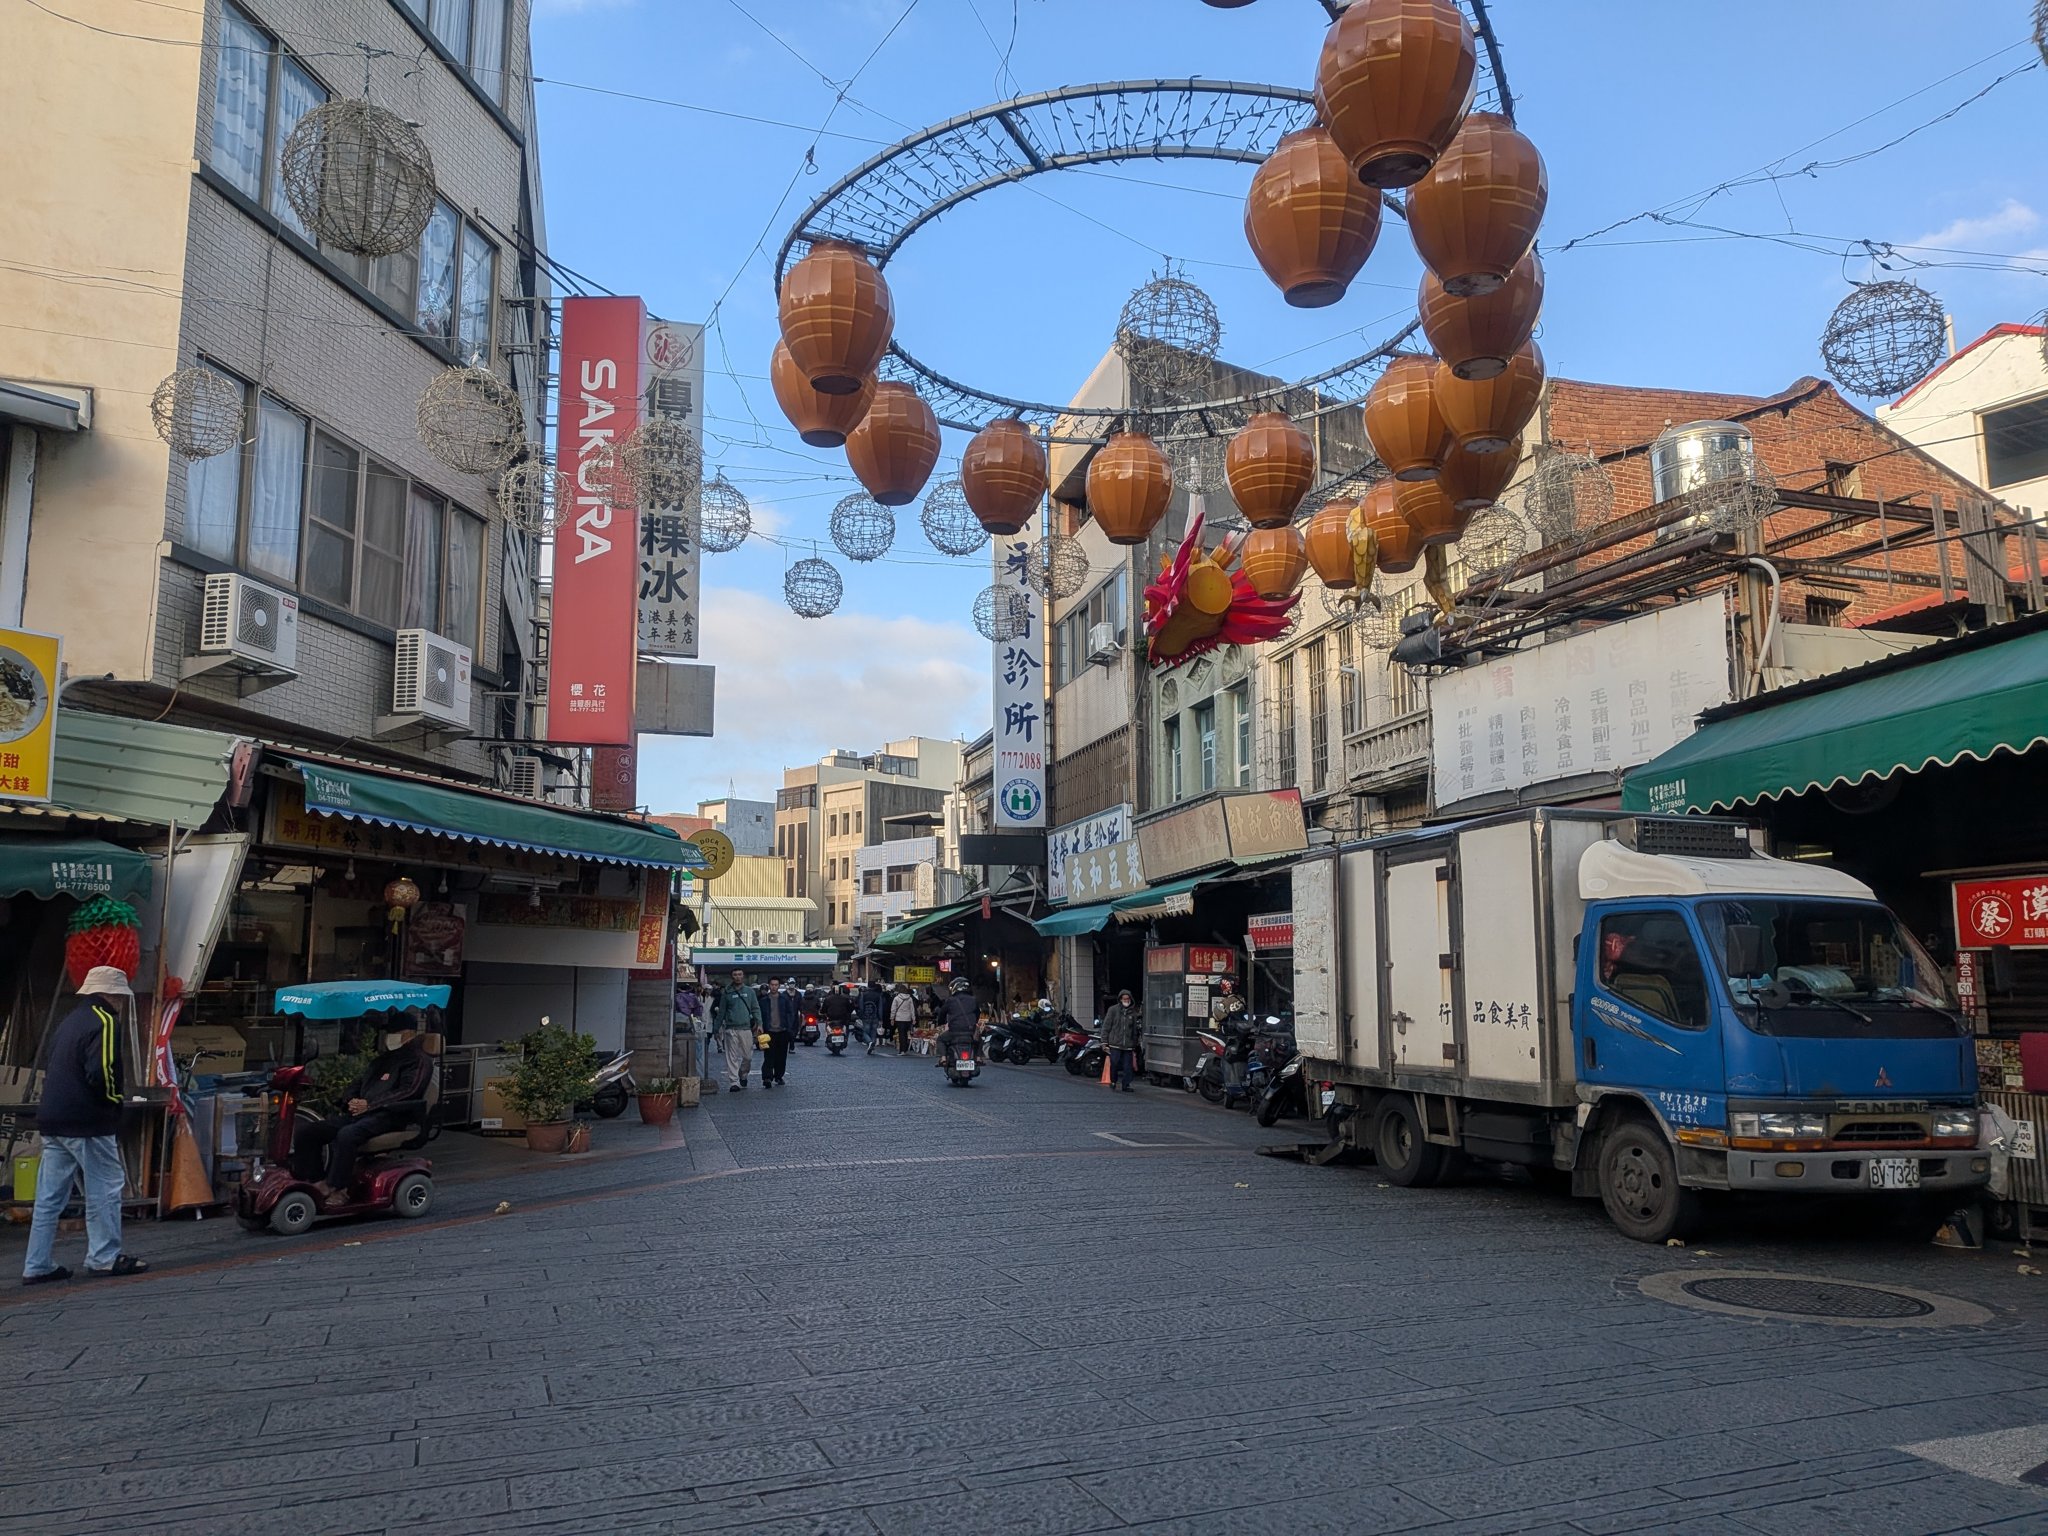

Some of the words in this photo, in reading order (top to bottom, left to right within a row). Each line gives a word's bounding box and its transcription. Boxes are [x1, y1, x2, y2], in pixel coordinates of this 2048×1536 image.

[575, 358, 617, 564] SAKURA
[570, 683, 606, 697] 櫻花
[1628, 679, 1650, 756] 肉品加工
[1001, 751, 1041, 770] 7772088
[1458, 722, 1475, 790] 批發零售
[1651, 798, 1686, 813] 04-7778500
[699, 837, 720, 846] DOCK
[1072, 841, 1142, 898] 永和豆漿
[55, 881, 111, 891] 04-7778500
[1978, 900, 2009, 934] 蔡
[759, 954, 798, 962] FamilyMart
[1958, 953, 1972, 976] 綜合
[1959, 983, 1971, 994] 50
[364, 993, 394, 1003] karma
